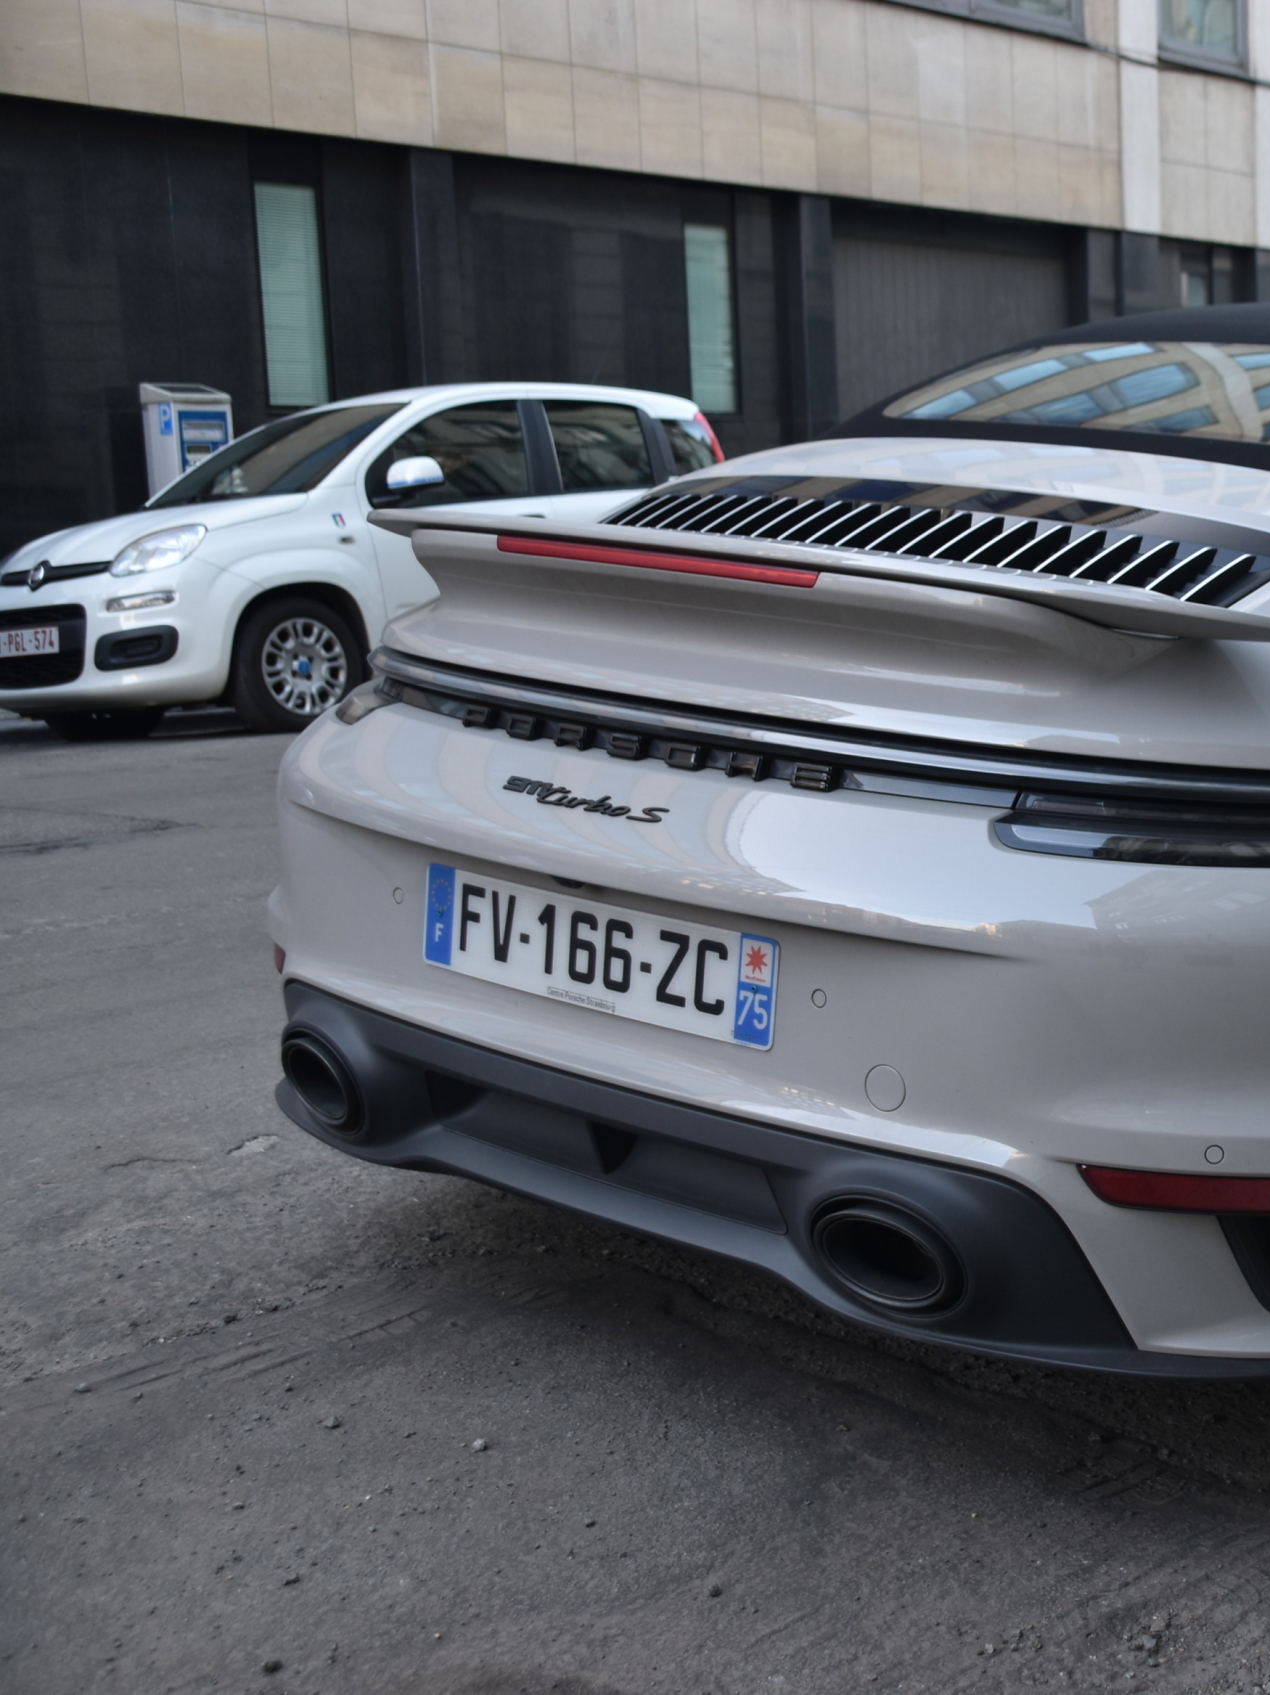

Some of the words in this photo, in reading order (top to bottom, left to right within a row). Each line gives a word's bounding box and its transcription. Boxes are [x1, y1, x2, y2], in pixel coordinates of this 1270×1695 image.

[160, 405, 171, 432] P
[462, 704, 838, 792] PORSCHE
[625, 806, 670, 823] S
[434, 922, 444, 943] F
[459, 883, 729, 1016] FV-166-ZC
[564, 990, 586, 1004] Porsche
[737, 989, 768, 1030] 75
